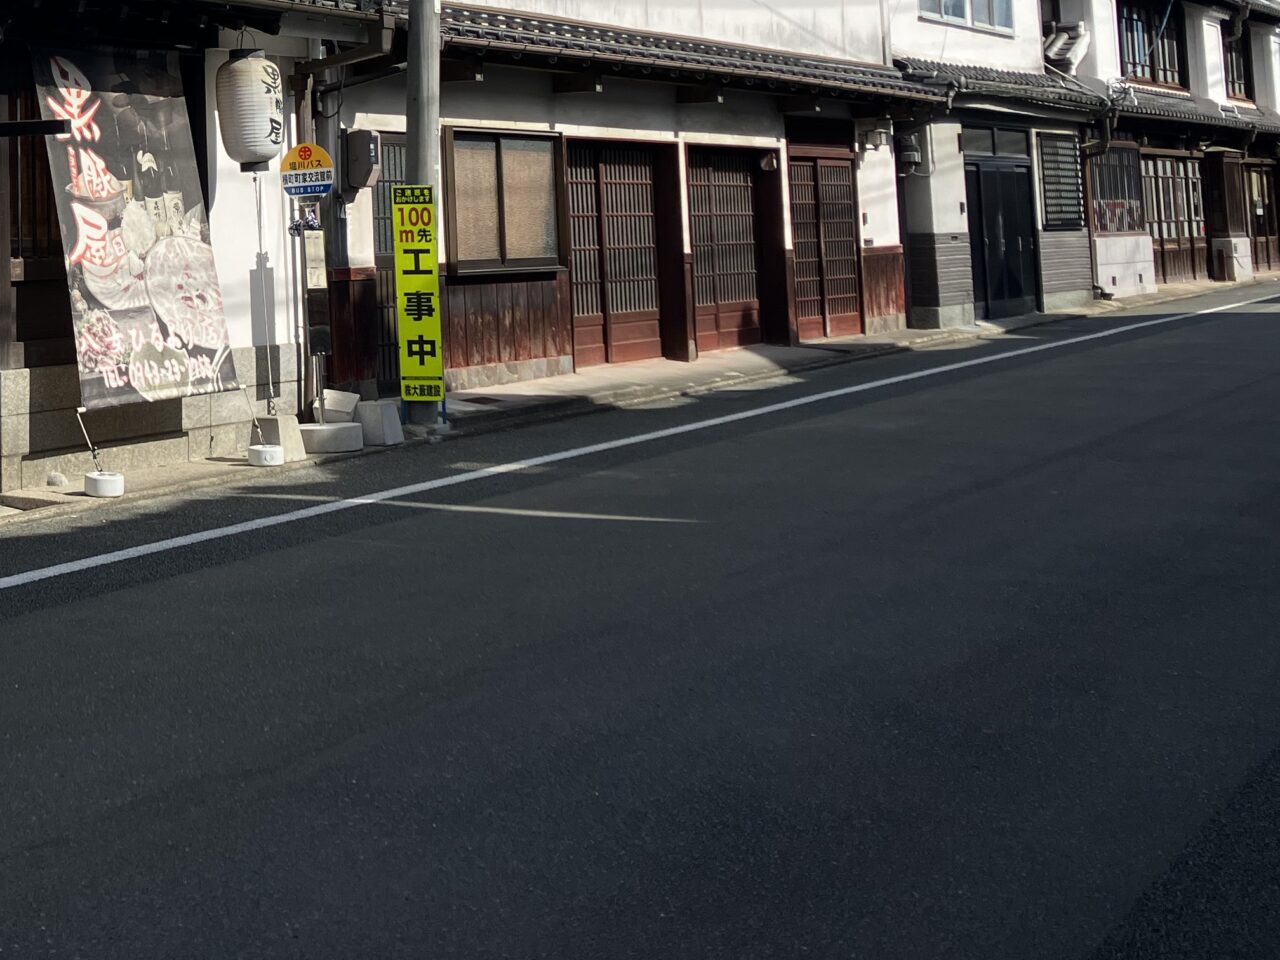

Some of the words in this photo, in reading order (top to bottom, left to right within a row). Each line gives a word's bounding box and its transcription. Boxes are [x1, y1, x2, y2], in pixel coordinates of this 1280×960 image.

[397, 207, 432, 227] 100
[402, 248, 438, 367] 工事中
